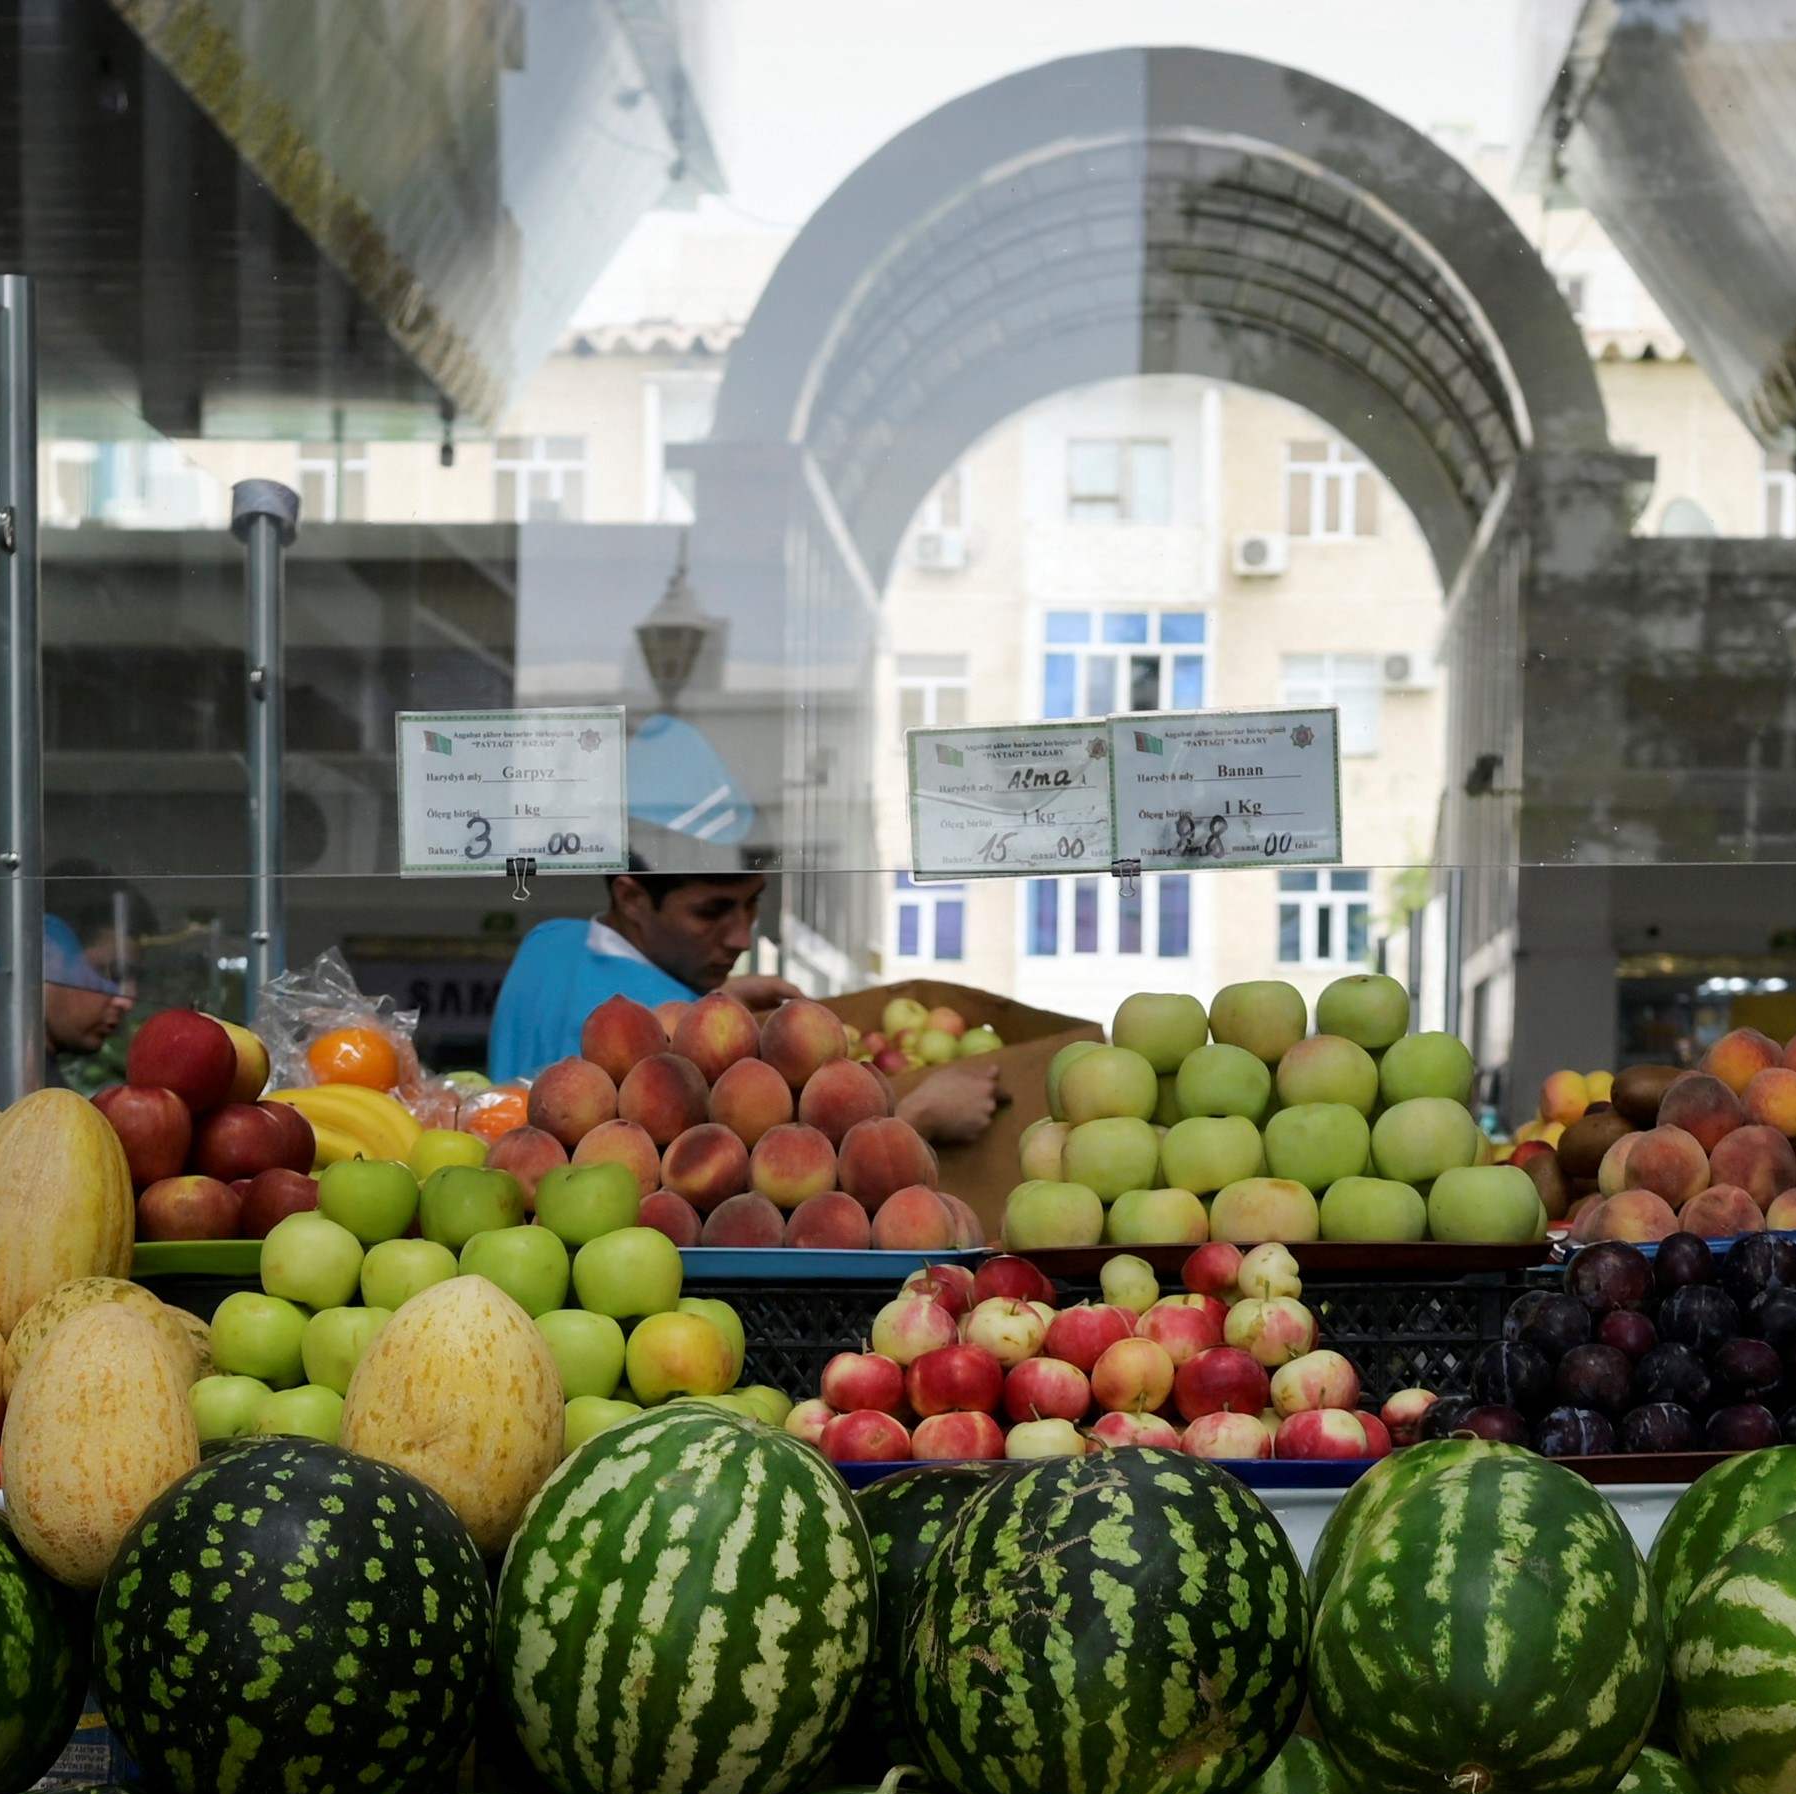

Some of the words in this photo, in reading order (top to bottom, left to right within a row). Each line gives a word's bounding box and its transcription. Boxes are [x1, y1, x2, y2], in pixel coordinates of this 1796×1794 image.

[502, 766, 555, 782] Garpyz
[1007, 767, 1072, 790] Alma
[1218, 764, 1264, 778] Banan
[514, 804, 520, 816] 1
[525, 804, 541, 817] kg
[1224, 800, 1230, 815] 1
[1238, 799, 1262, 816] Kg
[1022, 811, 1028, 825] 1
[1036, 809, 1055, 827] kg
[464, 817, 492, 860] 3
[548, 832, 581, 855] 00
[977, 832, 1018, 863] 15
[1057, 836, 1085, 859] 00
[1264, 832, 1292, 857] 00
